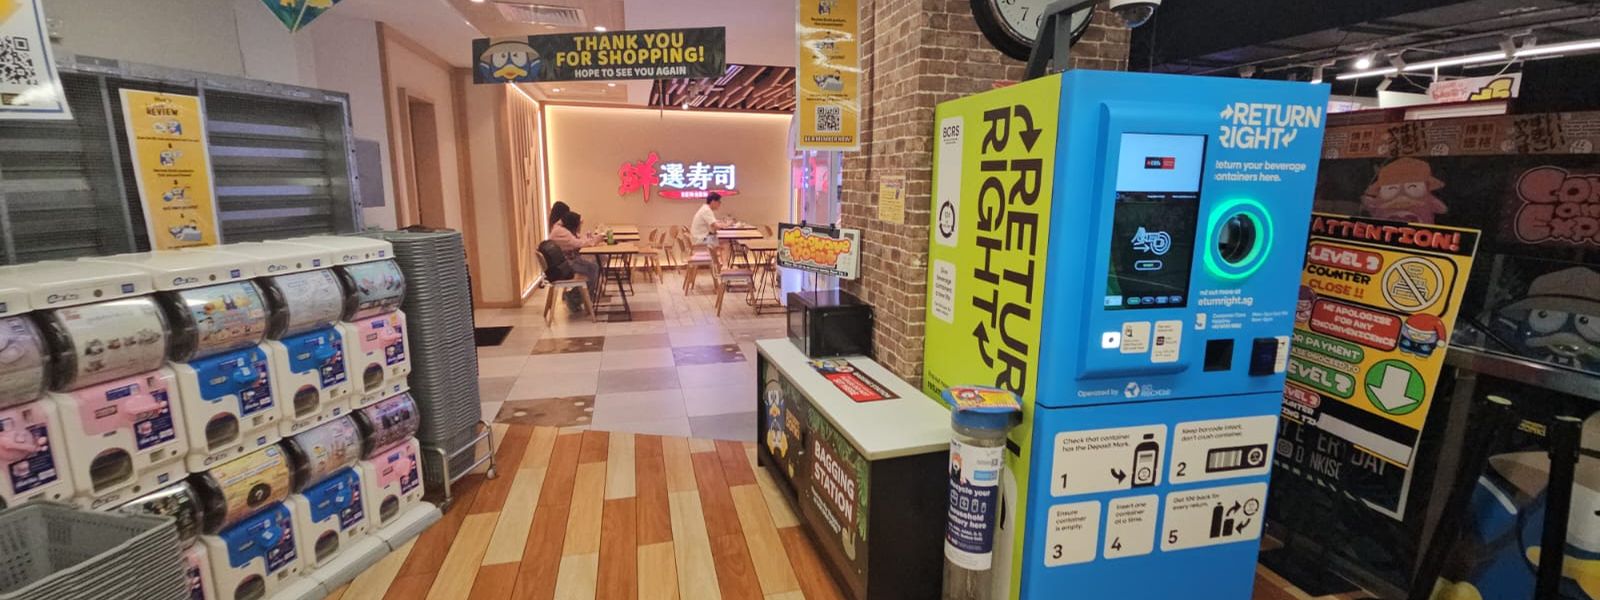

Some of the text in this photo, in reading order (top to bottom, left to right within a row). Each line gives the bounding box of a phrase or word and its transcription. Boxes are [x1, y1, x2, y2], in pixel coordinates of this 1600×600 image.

[574, 32, 685, 52] THANK YOU
[556, 45, 705, 67] FOR SHOPPING!
[575, 66, 687, 78] HOPE TO SEE YOU AGAIN
[146, 106, 179, 118] REVIEW
[1233, 102, 1322, 128] RETURN
[943, 125, 960, 139] BCRS
[1219, 126, 1285, 149] RIGHT
[1264, 160, 1307, 173] beverage
[971, 106, 1011, 329] RIGHT
[1312, 217, 1462, 252] ATTENTION!
[1309, 246, 1380, 271] LEVEL 3
[1307, 264, 1371, 286] COUNTER
[1309, 279, 1365, 300] CLOSE !!
[1323, 303, 1335, 312] WE
[1334, 315, 1374, 331] FOR ANY
[1292, 333, 1360, 360] OR PAYMENT
[1288, 360, 1333, 389] EVEL
[1062, 433, 1131, 446] Check that container
[1062, 444, 1074, 453] has
[1075, 443, 1087, 452] the
[1087, 442, 1112, 452] Deposit
[814, 440, 855, 501] BAGGING
[1176, 462, 1186, 477] 2
[1060, 473, 1068, 489] 1
[814, 462, 853, 522] STATION
[974, 489, 991, 499] your
[1056, 509, 1079, 518] Ensure
[1056, 516, 1087, 525] container
[1115, 509, 1145, 518] container
[969, 521, 987, 531] here
[1111, 537, 1122, 552] 4
[1168, 530, 1178, 545] 5
[1052, 544, 1063, 559] 3
